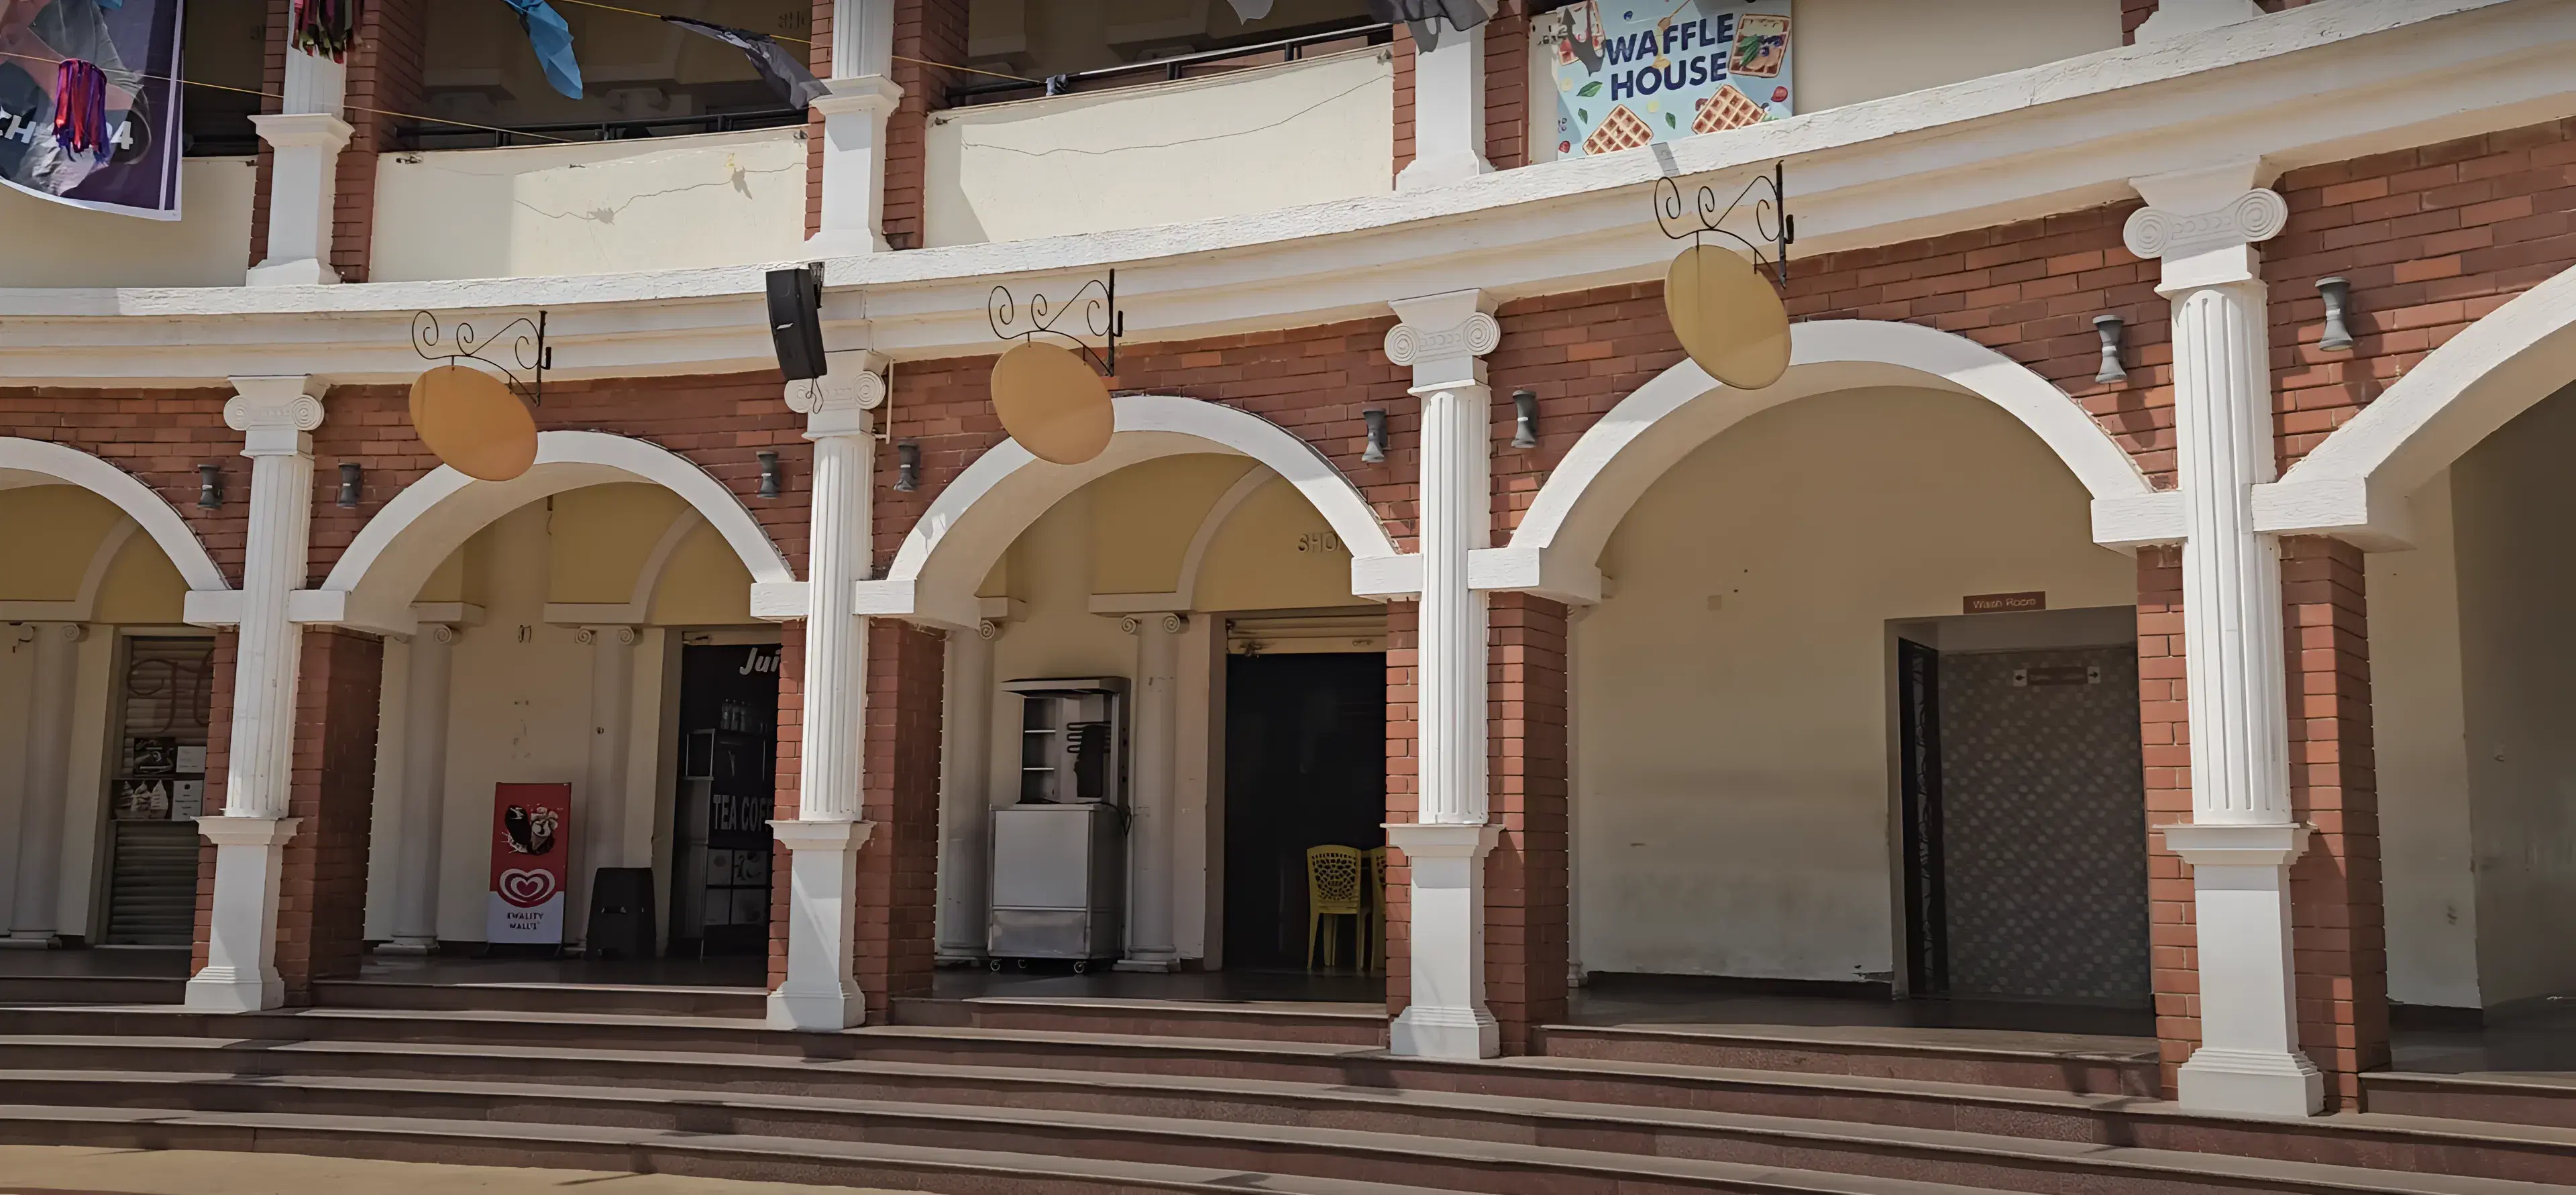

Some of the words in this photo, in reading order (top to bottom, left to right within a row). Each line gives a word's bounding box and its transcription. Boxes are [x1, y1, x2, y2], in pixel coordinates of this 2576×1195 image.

[1606, 13, 1733, 66] WAFFLE
[1611, 51, 1727, 101] HOUSE
[1297, 531, 1342, 553] SHO
[713, 794, 737, 832] TEA
